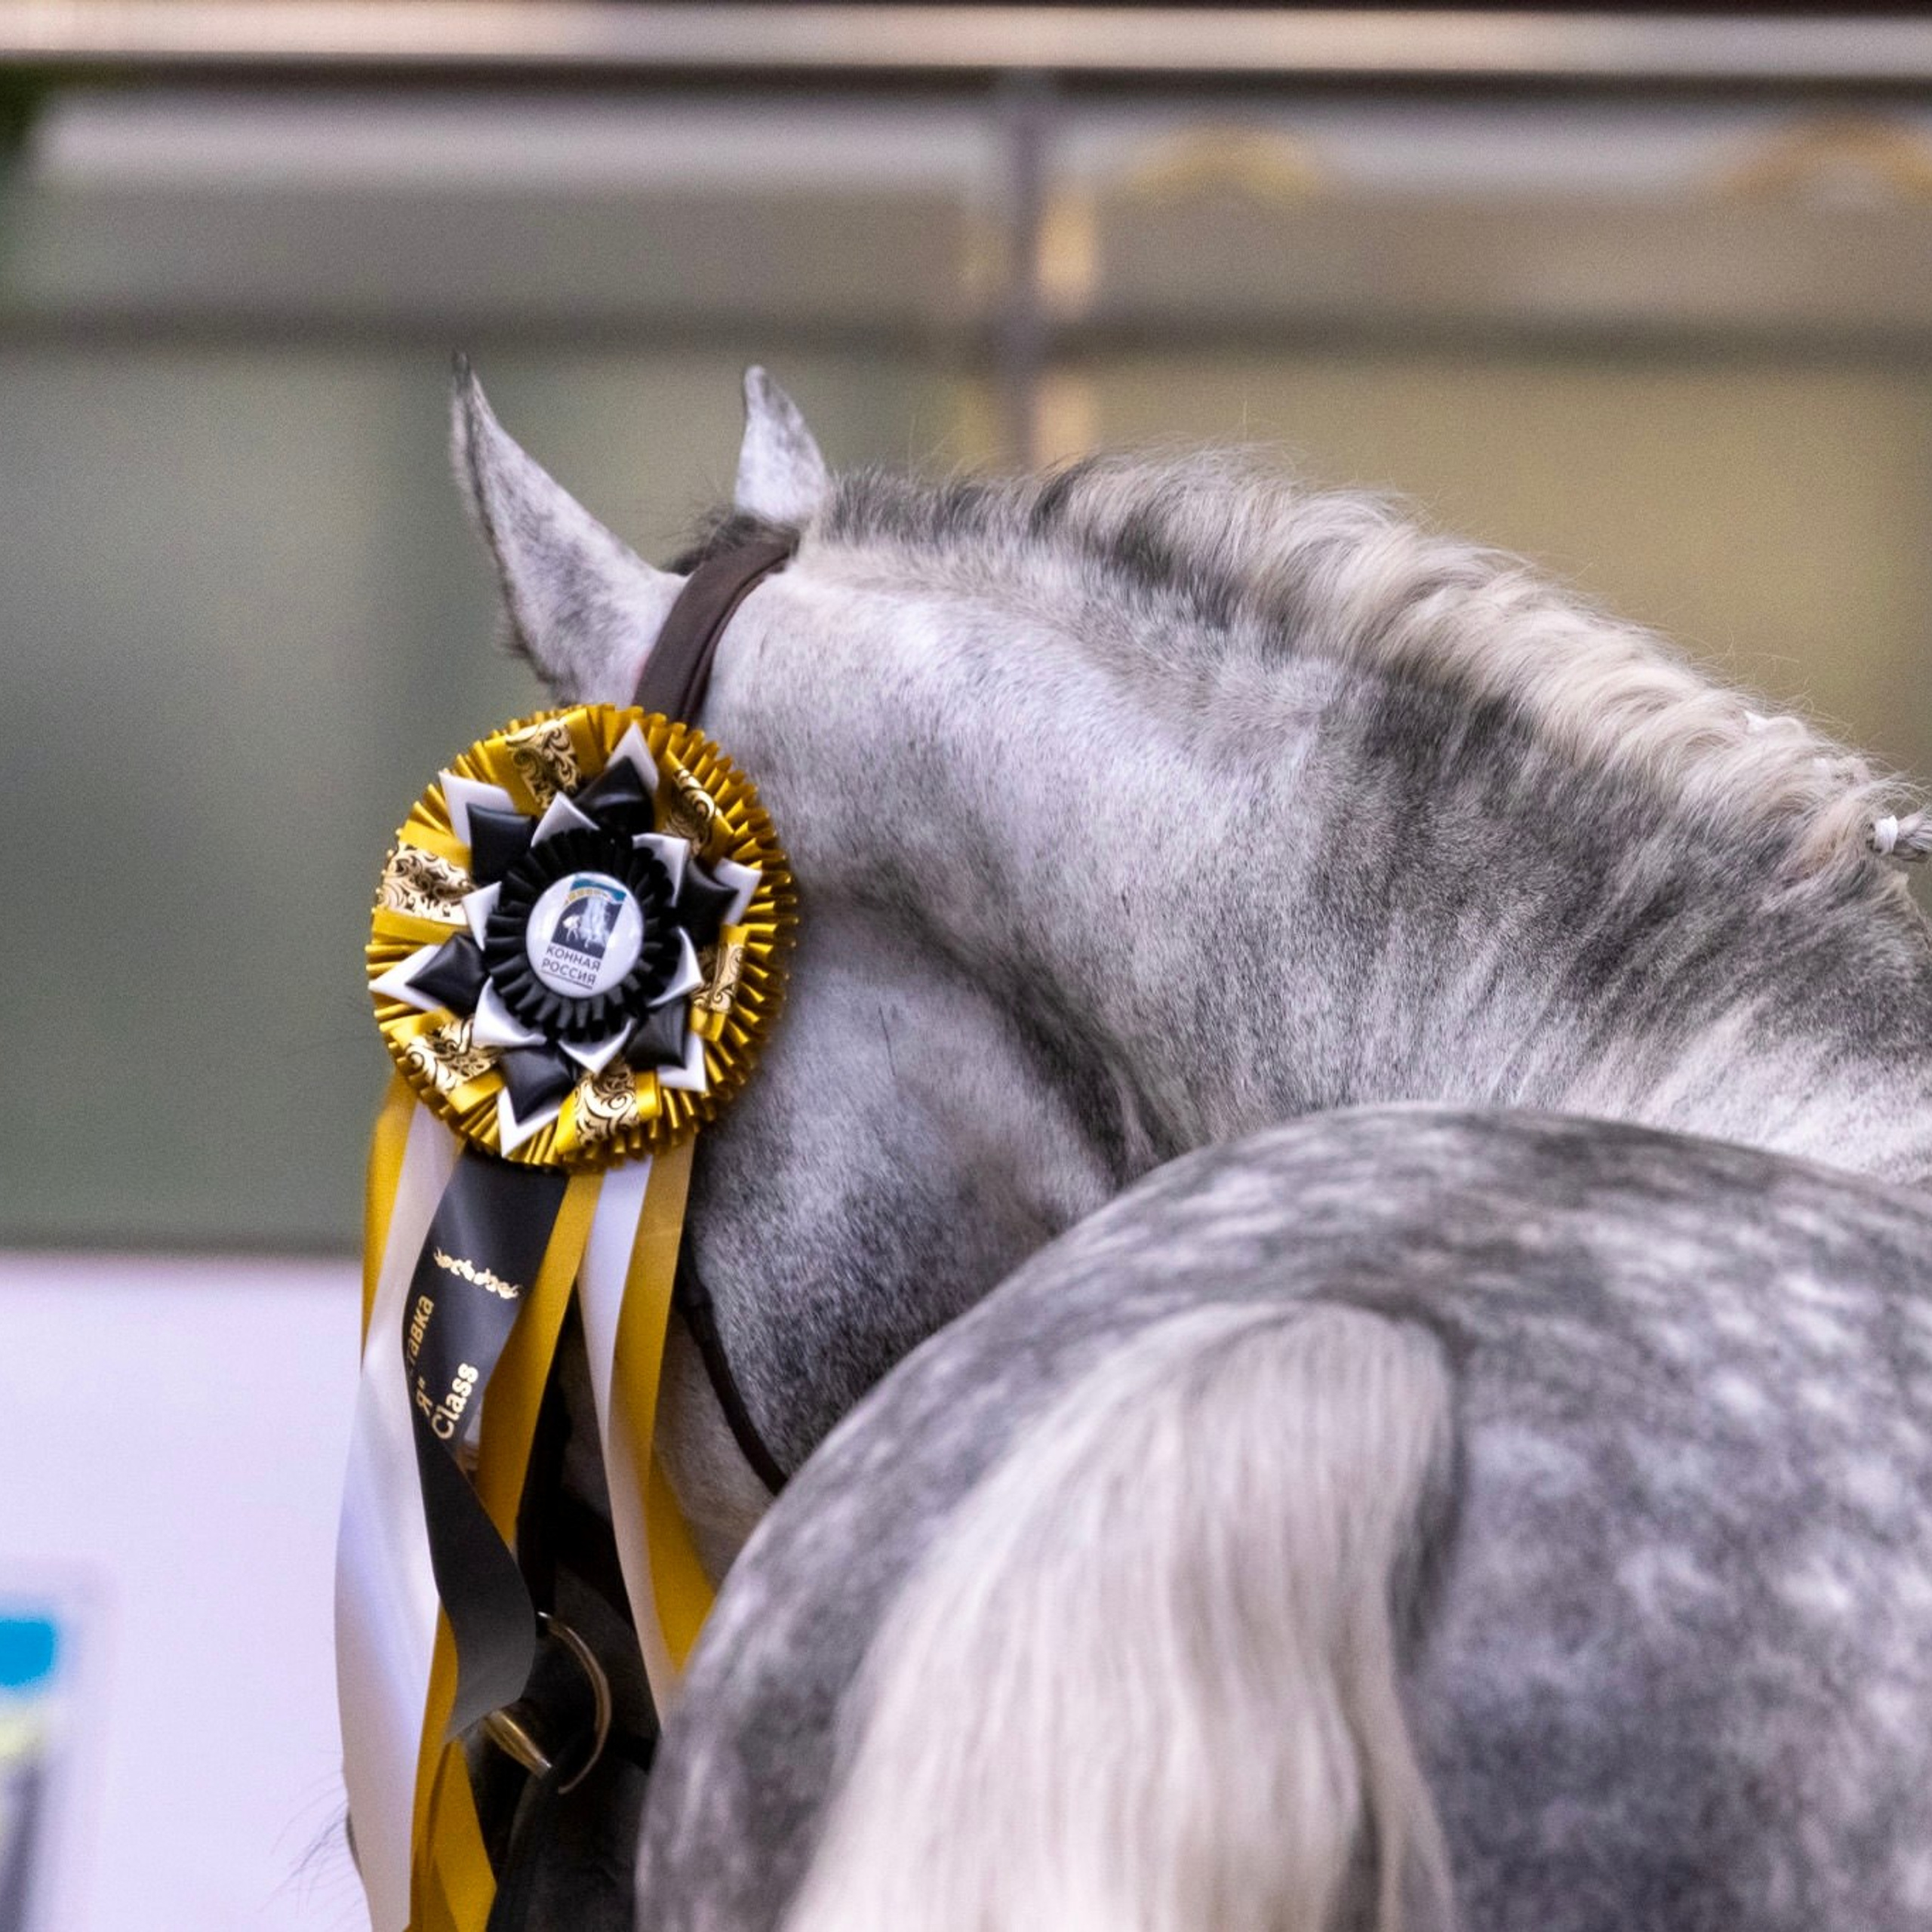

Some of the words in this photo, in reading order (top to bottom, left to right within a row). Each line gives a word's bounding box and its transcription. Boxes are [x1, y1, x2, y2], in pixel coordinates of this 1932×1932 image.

[542, 958, 597, 986] РОССИЯ
[546, 946, 601, 973] КОННАЯ
[408, 1295, 434, 1369] тавка
[432, 1362, 478, 1439] Class
